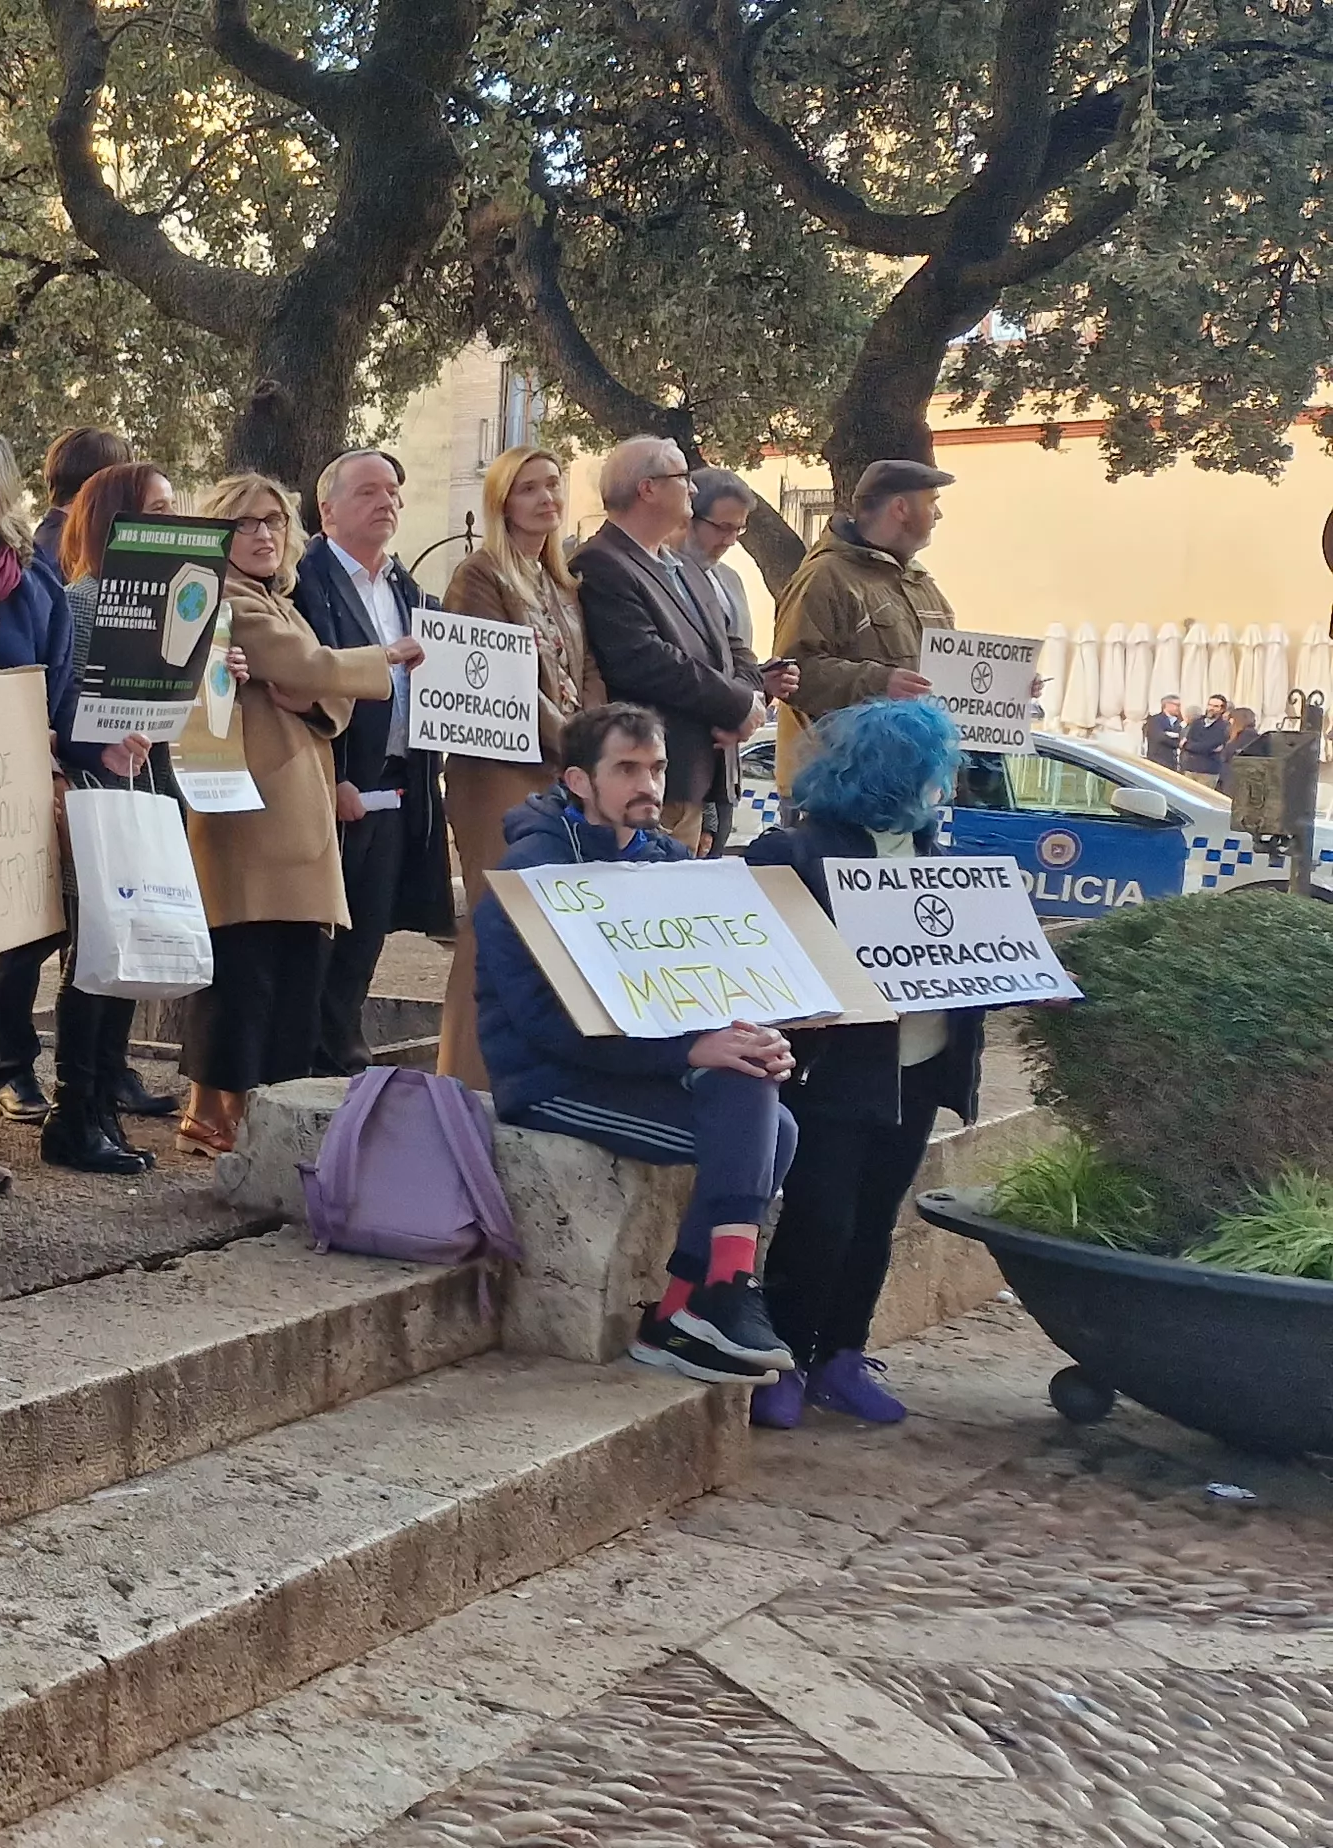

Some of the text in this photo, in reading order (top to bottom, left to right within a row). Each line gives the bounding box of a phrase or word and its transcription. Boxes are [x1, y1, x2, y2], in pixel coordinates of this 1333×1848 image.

[99, 594, 138, 606] POR LA
[101, 579, 167, 596] ENTIERRO
[421, 619, 532, 656] NO AL RECORTE
[930, 636, 1035, 663] NO AL RECORTE
[419, 687, 531, 722] COOPERACIÓN
[97, 718, 132, 731] HUESCA
[135, 720, 145, 731] ES
[419, 720, 530, 752] AL DESARROLLO
[955, 724, 1024, 746] SARROLLO
[837, 866, 1012, 891] NO AL RECORTE
[536, 879, 604, 912] LOS
[597, 914, 768, 952] RECORTES
[856, 934, 1041, 969] COOPERACIÓN
[618, 965, 803, 1022] MATAN
[905, 972, 1060, 1001] DESARROLLO
